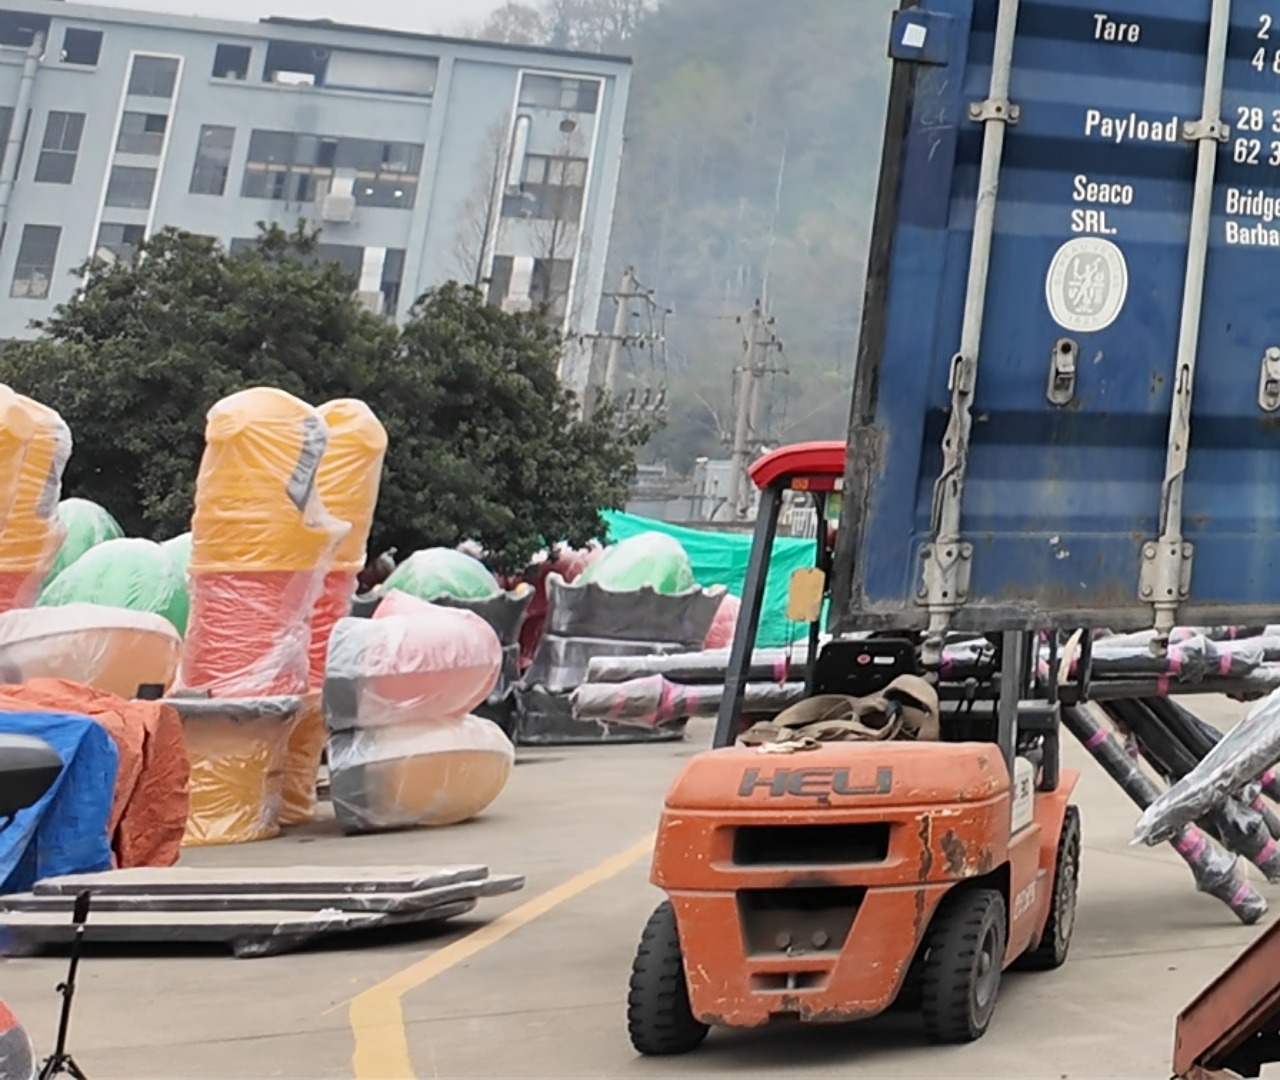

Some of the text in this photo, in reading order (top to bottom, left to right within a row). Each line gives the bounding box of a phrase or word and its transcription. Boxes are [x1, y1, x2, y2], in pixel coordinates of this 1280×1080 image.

[1094, 14, 1140, 42] Tare
[1257, 14, 1272, 39] 2
[1252, 47, 1265, 72] 4
[1085, 109, 1178, 144] Payload
[1236, 106, 1264, 131] 28
[1234, 137, 1261, 164] 62
[1072, 174, 1133, 205] Seaco
[1071, 208, 1117, 235] SRL.
[738, 766, 894, 797] HELI
